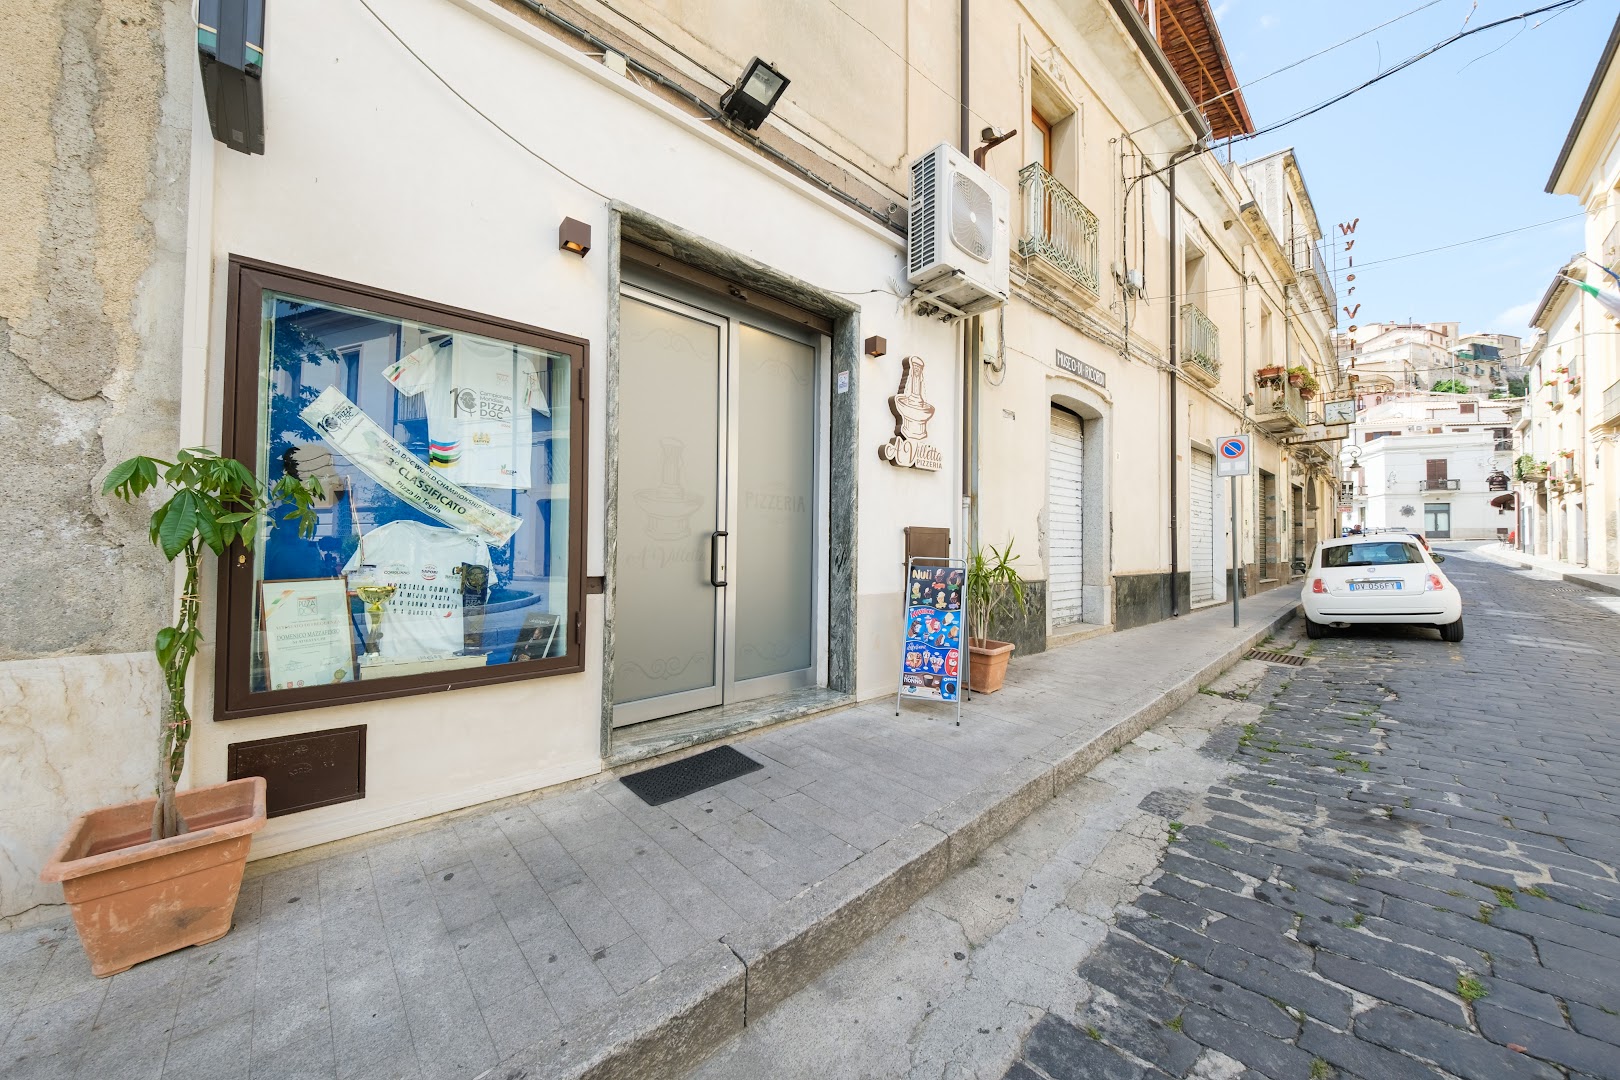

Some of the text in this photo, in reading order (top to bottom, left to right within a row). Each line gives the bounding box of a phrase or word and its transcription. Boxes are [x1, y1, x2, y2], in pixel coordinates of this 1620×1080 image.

[480, 390, 512, 401] Campionato
[480, 396, 504, 404] Mondiale
[337, 406, 353, 420] PIZZA
[480, 402, 511, 414] PIZZA
[342, 412, 354, 424] DOC
[480, 409, 504, 420] DOC
[904, 440, 942, 464] Villetta
[916, 459, 942, 469] PIZZERIA
[382, 439, 496, 516] PIZZA DOC WORLD CHAMPIONSHIP 2024
[398, 466, 467, 515] CLASSIFICATO
[396, 480, 441, 514] Pizza in Teglia
[745, 490, 806, 513] PIZZERIA
[277, 633, 306, 641] DOMENICO
